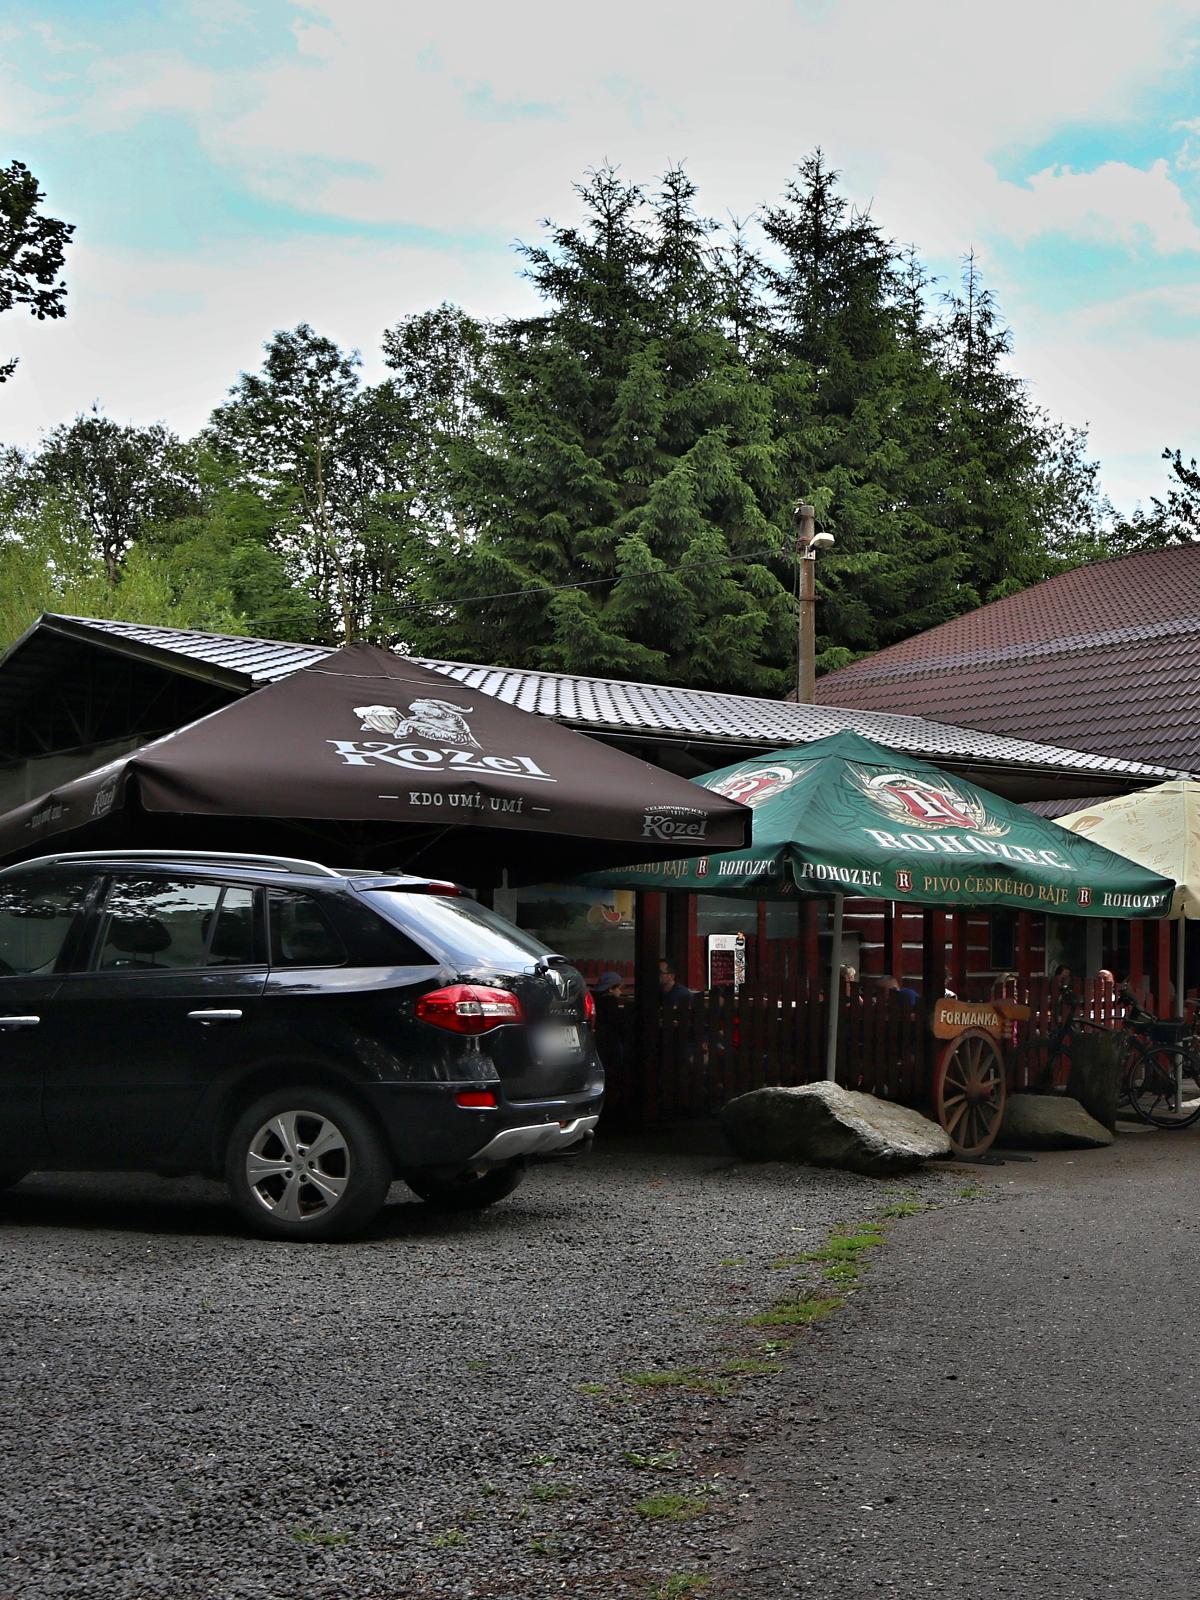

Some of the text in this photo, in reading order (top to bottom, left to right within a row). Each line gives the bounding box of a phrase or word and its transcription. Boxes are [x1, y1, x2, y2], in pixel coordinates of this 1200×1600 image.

[326, 739, 557, 782] Kozel
[409, 792, 523, 813] KDO UMÍ, UMÍ
[640, 815, 707, 840] Kozel
[863, 828, 1074, 871] ROHOZEC
[718, 860, 776, 875] ROHOZEC
[800, 862, 882, 887] ROHOZEC
[924, 876, 960, 892] PIVO
[964, 875, 1034, 899] ČESKÉHO
[1038, 884, 1069, 905] RÁJE
[940, 1009, 999, 1026] FORMANKA
